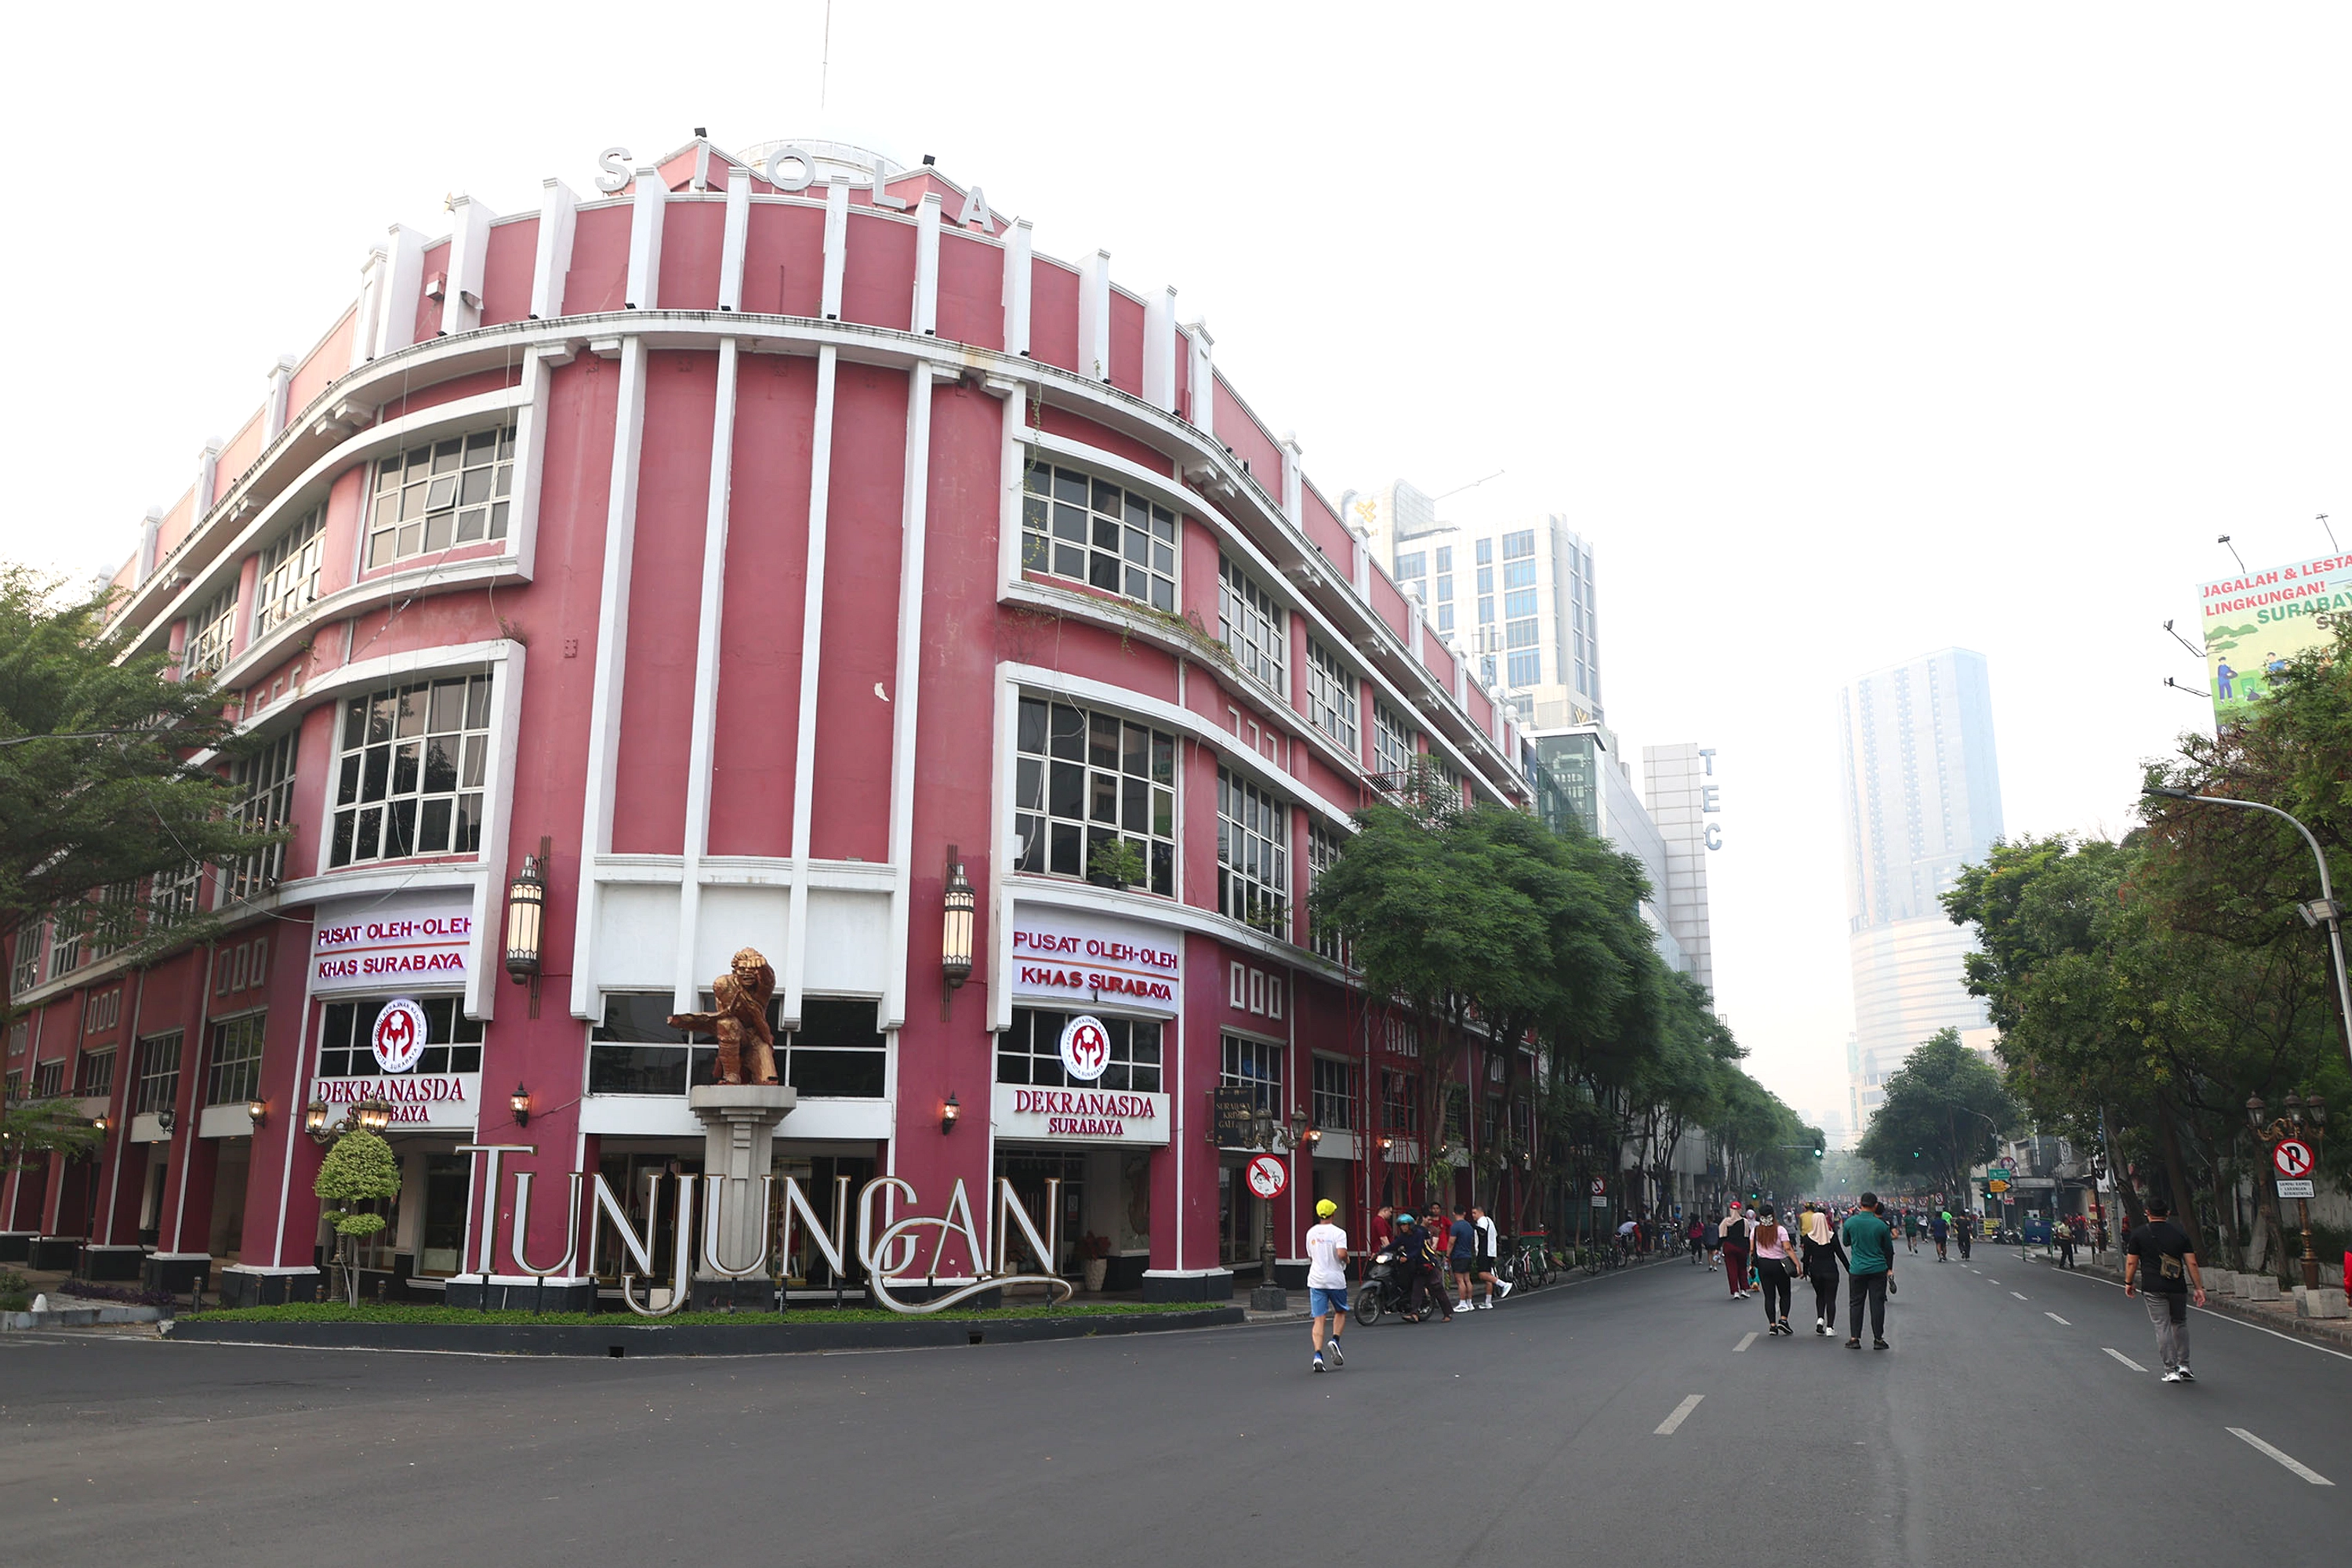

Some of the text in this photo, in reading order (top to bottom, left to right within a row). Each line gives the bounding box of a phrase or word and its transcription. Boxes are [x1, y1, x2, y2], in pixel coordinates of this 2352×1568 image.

[595, 140, 994, 233] SIOLA
[2203, 572, 2278, 597] JAGALAH
[2284, 568, 2298, 580] &
[2205, 581, 2325, 616] LINGKUNGAN!
[1699, 749, 1722, 851] TEC
[318, 917, 472, 946] PUSAT OLEH-OLEH
[1014, 931, 1178, 969] PUSAT OLEH-OLEH
[318, 953, 464, 978] KHAS SURABAYA
[1021, 967, 1173, 1000] KHAS SURABAYA
[318, 1077, 466, 1103] DEKRANASDA
[1014, 1090, 1156, 1118] DEKRANASDA
[347, 1105, 430, 1123] SBAYA
[1048, 1117, 1123, 1134] SURABAYA
[454, 1144, 1073, 1317] TUNJUNGAN
